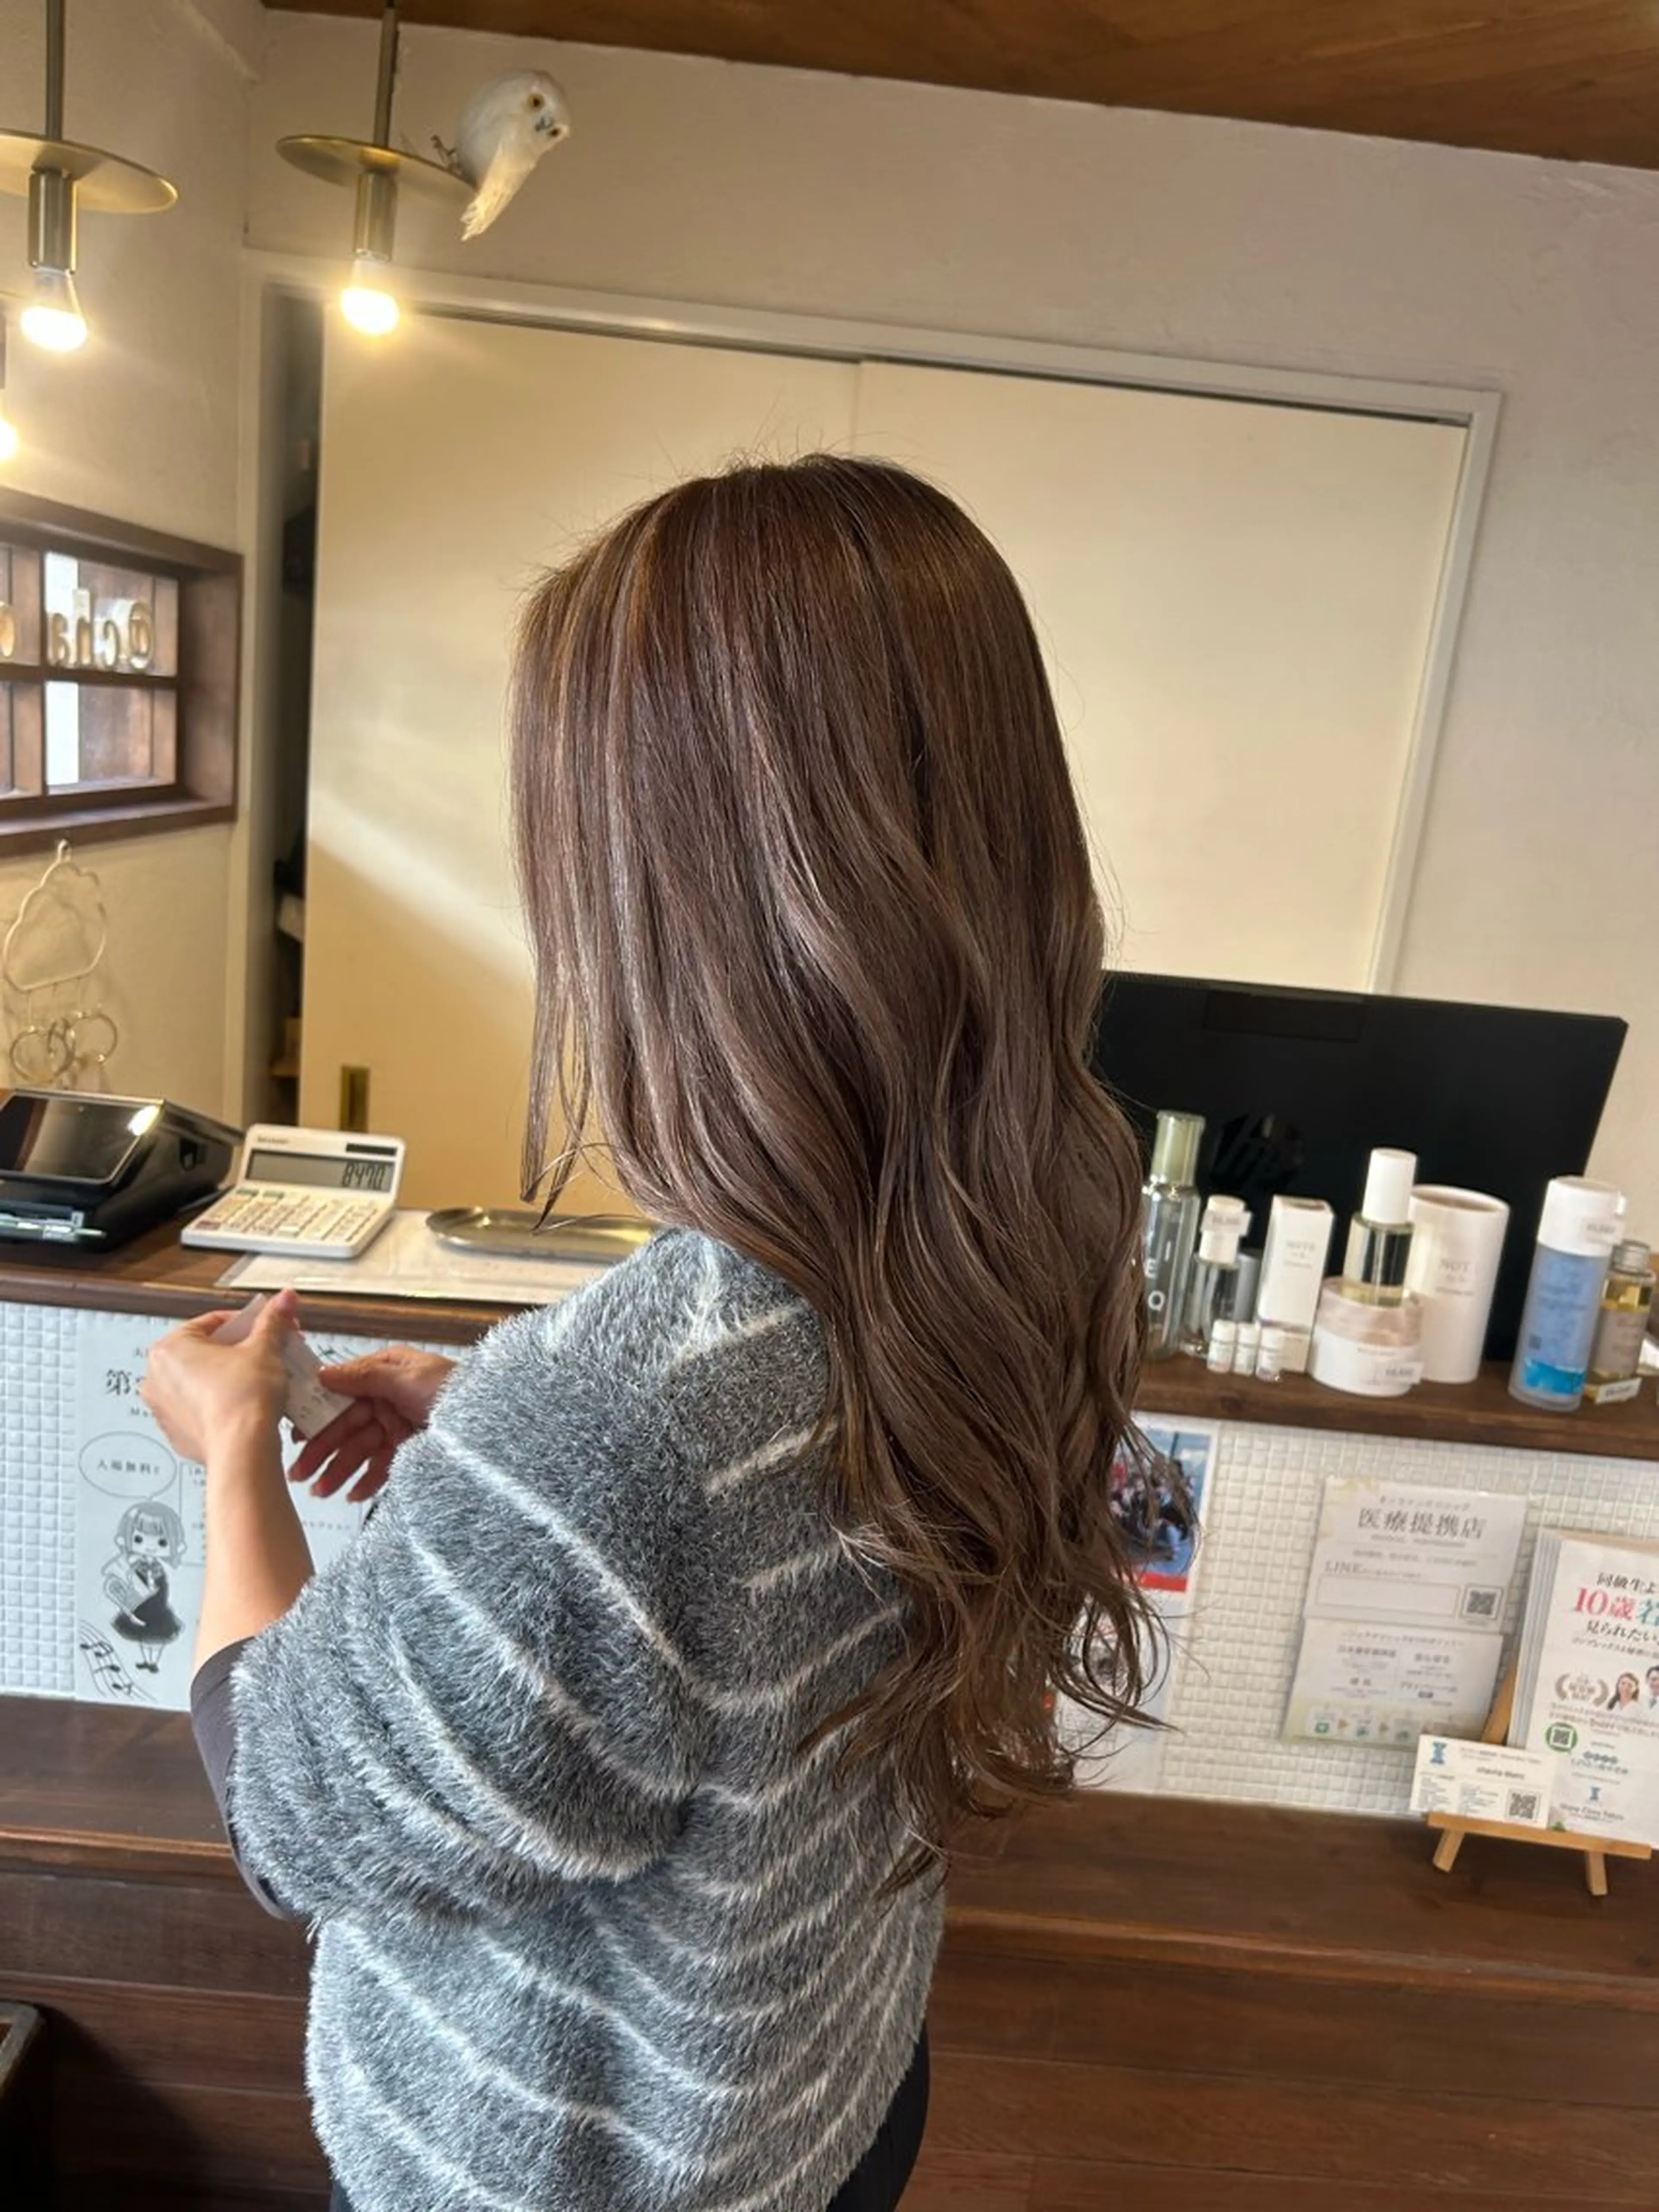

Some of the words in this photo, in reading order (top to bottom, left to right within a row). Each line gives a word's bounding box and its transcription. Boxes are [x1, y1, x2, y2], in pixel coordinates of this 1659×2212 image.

[342, 1161, 386, 1190] 8470
[1357, 1508, 1487, 1539] 医療提携店
